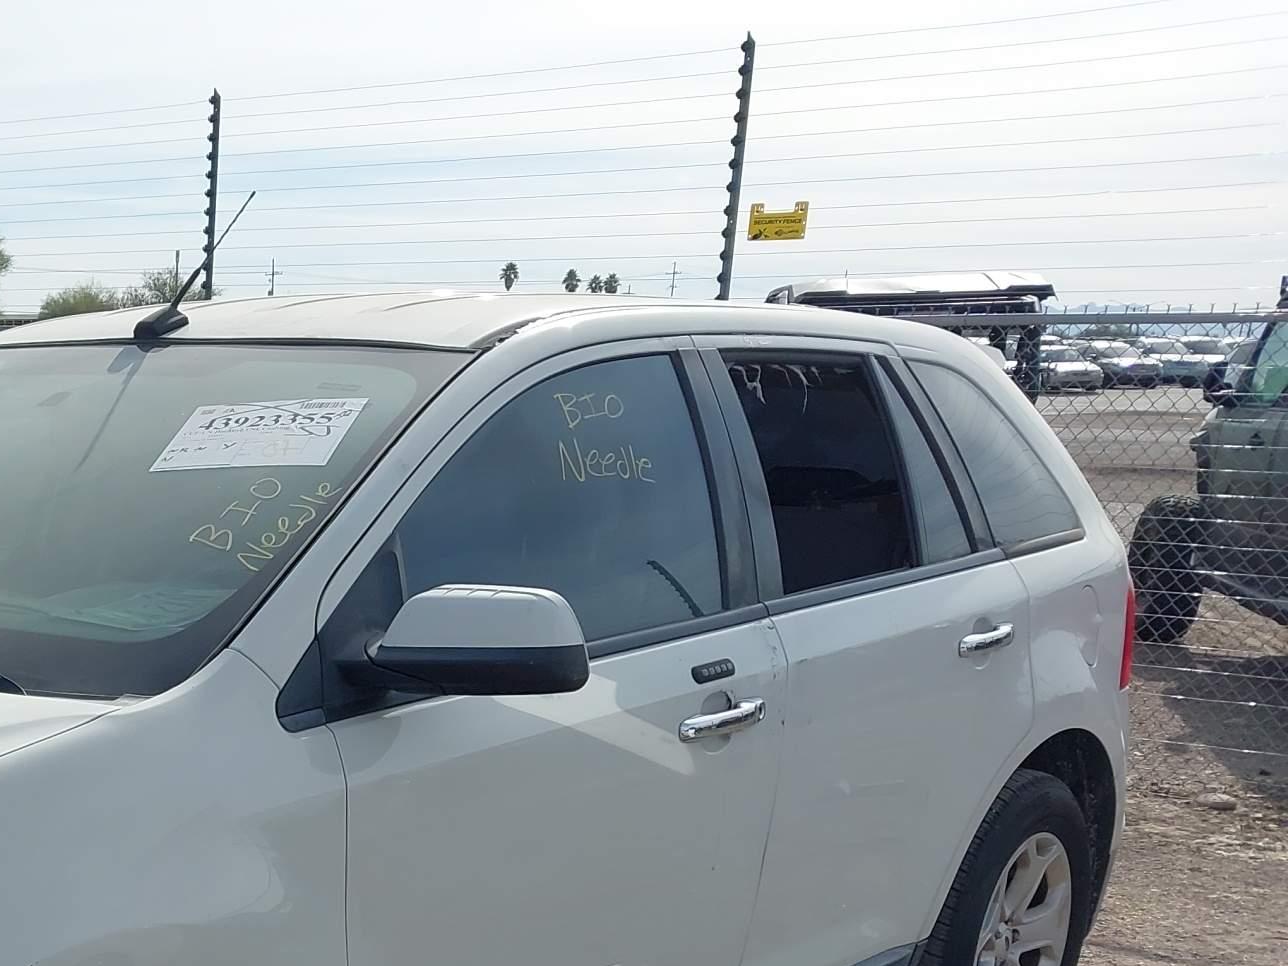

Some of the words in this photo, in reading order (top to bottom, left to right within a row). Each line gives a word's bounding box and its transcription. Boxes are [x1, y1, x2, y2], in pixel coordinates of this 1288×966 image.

[199, 411, 334, 432] 43923355
[553, 393, 624, 428] BIO
[559, 437, 656, 483] Needle
[189, 478, 281, 551] BIO
[237, 482, 343, 571] Needle
